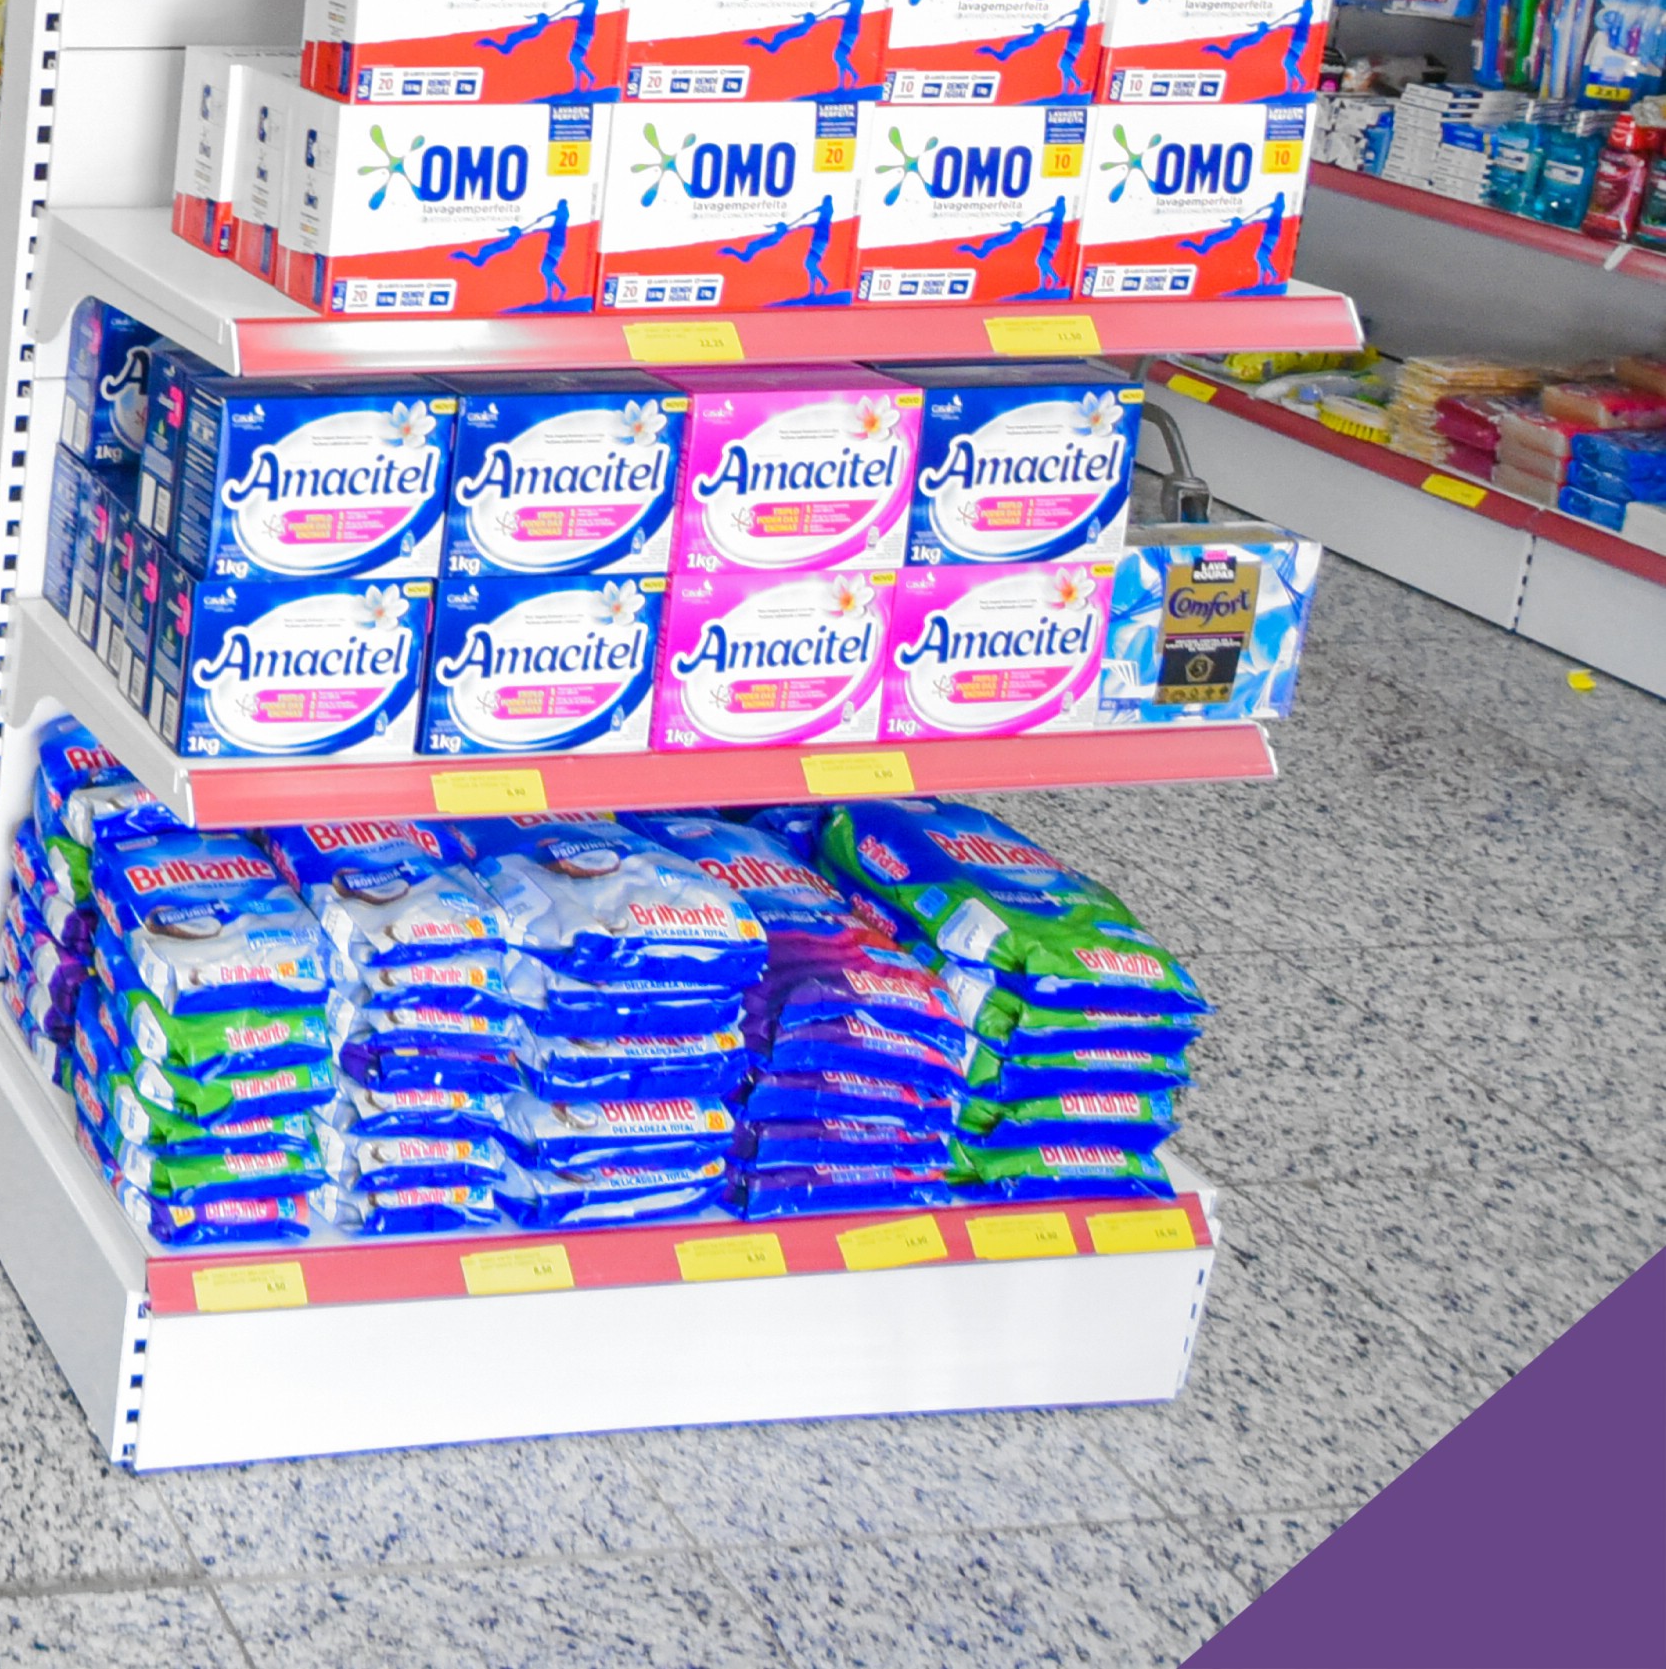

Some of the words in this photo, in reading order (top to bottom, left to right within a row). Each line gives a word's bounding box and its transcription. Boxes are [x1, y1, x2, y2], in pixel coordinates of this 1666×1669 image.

[229, 450, 434, 502] Amacitel
[464, 448, 663, 500] Amacitel
[698, 445, 898, 496] Amacitel
[924, 439, 1120, 489] Amacitel
[215, 558, 249, 580] 1kg
[448, 555, 481, 577] 1kg
[686, 552, 719, 572] 1kg
[910, 543, 943, 565] 1kg
[1168, 587, 1251, 630] Comfort
[200, 631, 408, 683] Amacitel
[444, 630, 641, 680] Amacitel
[678, 616, 872, 674] Amacitel
[900, 615, 1094, 665] Amacitel
[430, 733, 462, 755] 1kg
[126, 856, 275, 894] Brilhante
[628, 902, 729, 929] Brilhante
[1074, 949, 1164, 979] Brilhante
